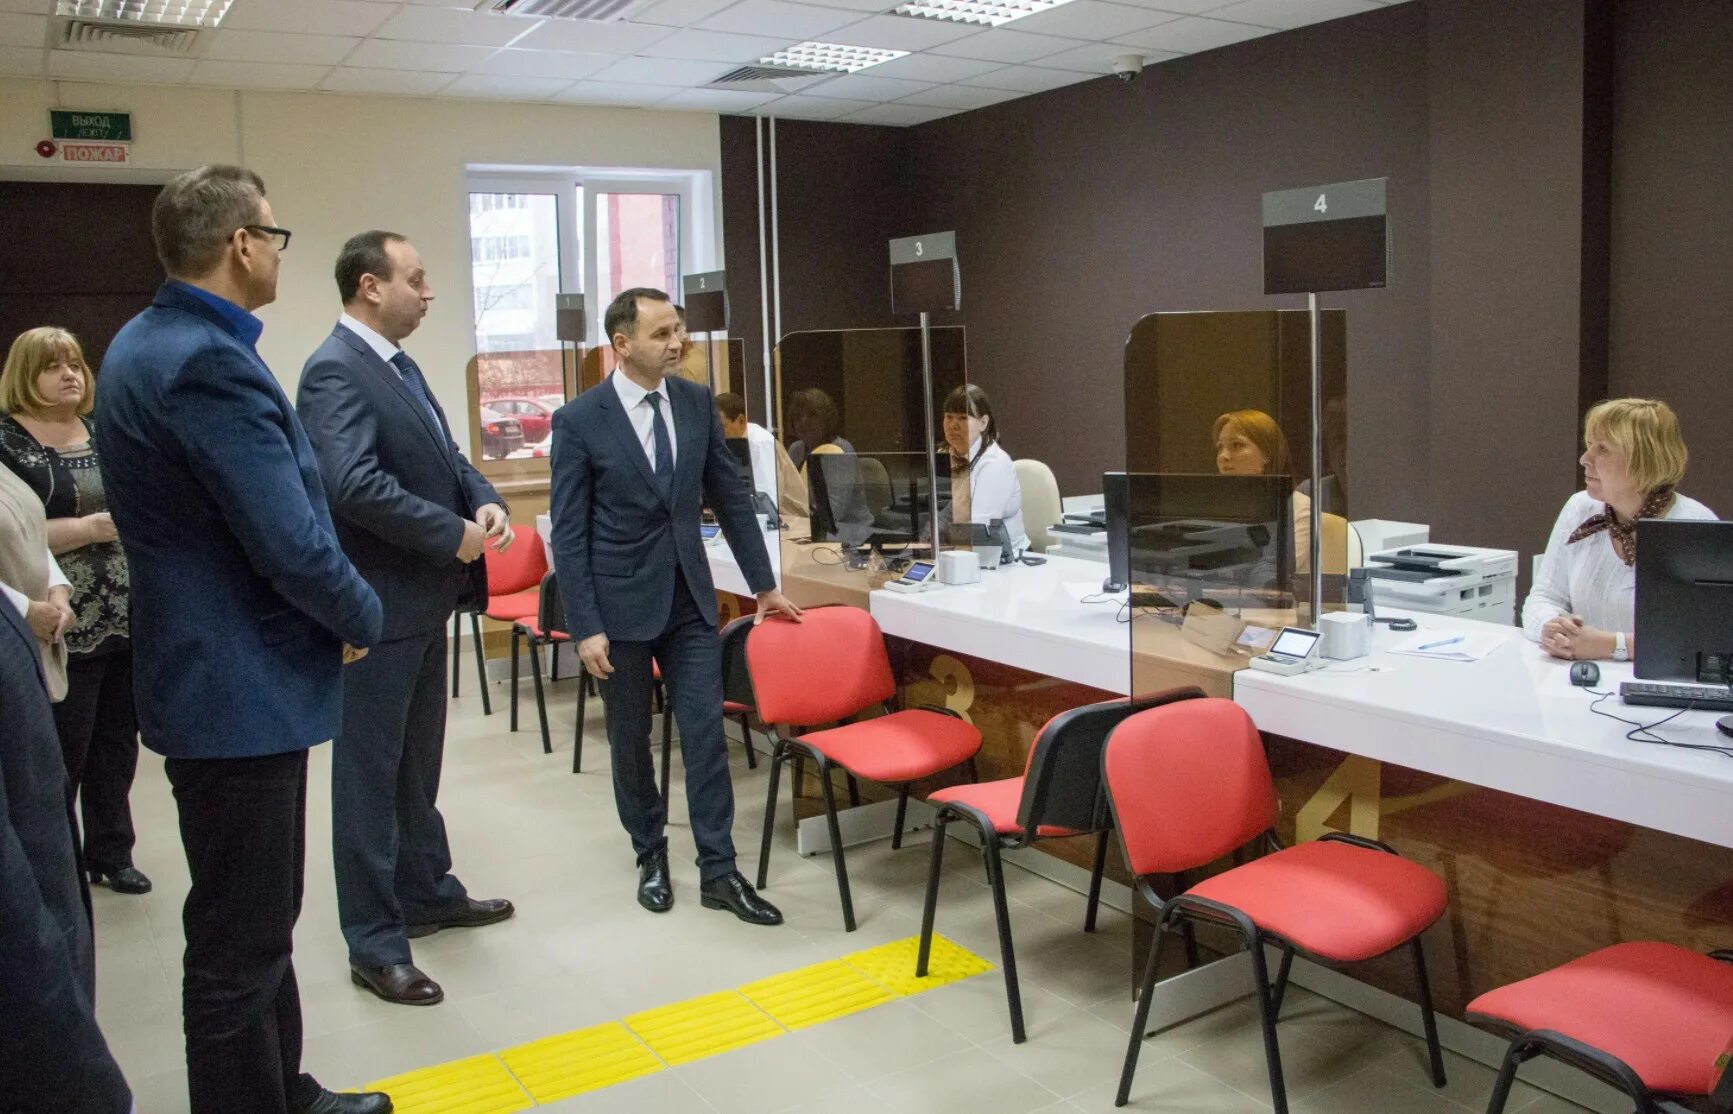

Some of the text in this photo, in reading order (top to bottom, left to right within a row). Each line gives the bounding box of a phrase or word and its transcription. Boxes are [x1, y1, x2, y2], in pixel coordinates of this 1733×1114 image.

[72, 115, 111, 128] ВЫХОД
[66, 146, 123, 161] ПОЖАР
[1313, 193, 1328, 213] 4
[915, 241, 923, 256] 3
[699, 277, 706, 289] 2
[1296, 754, 1382, 843] 4
